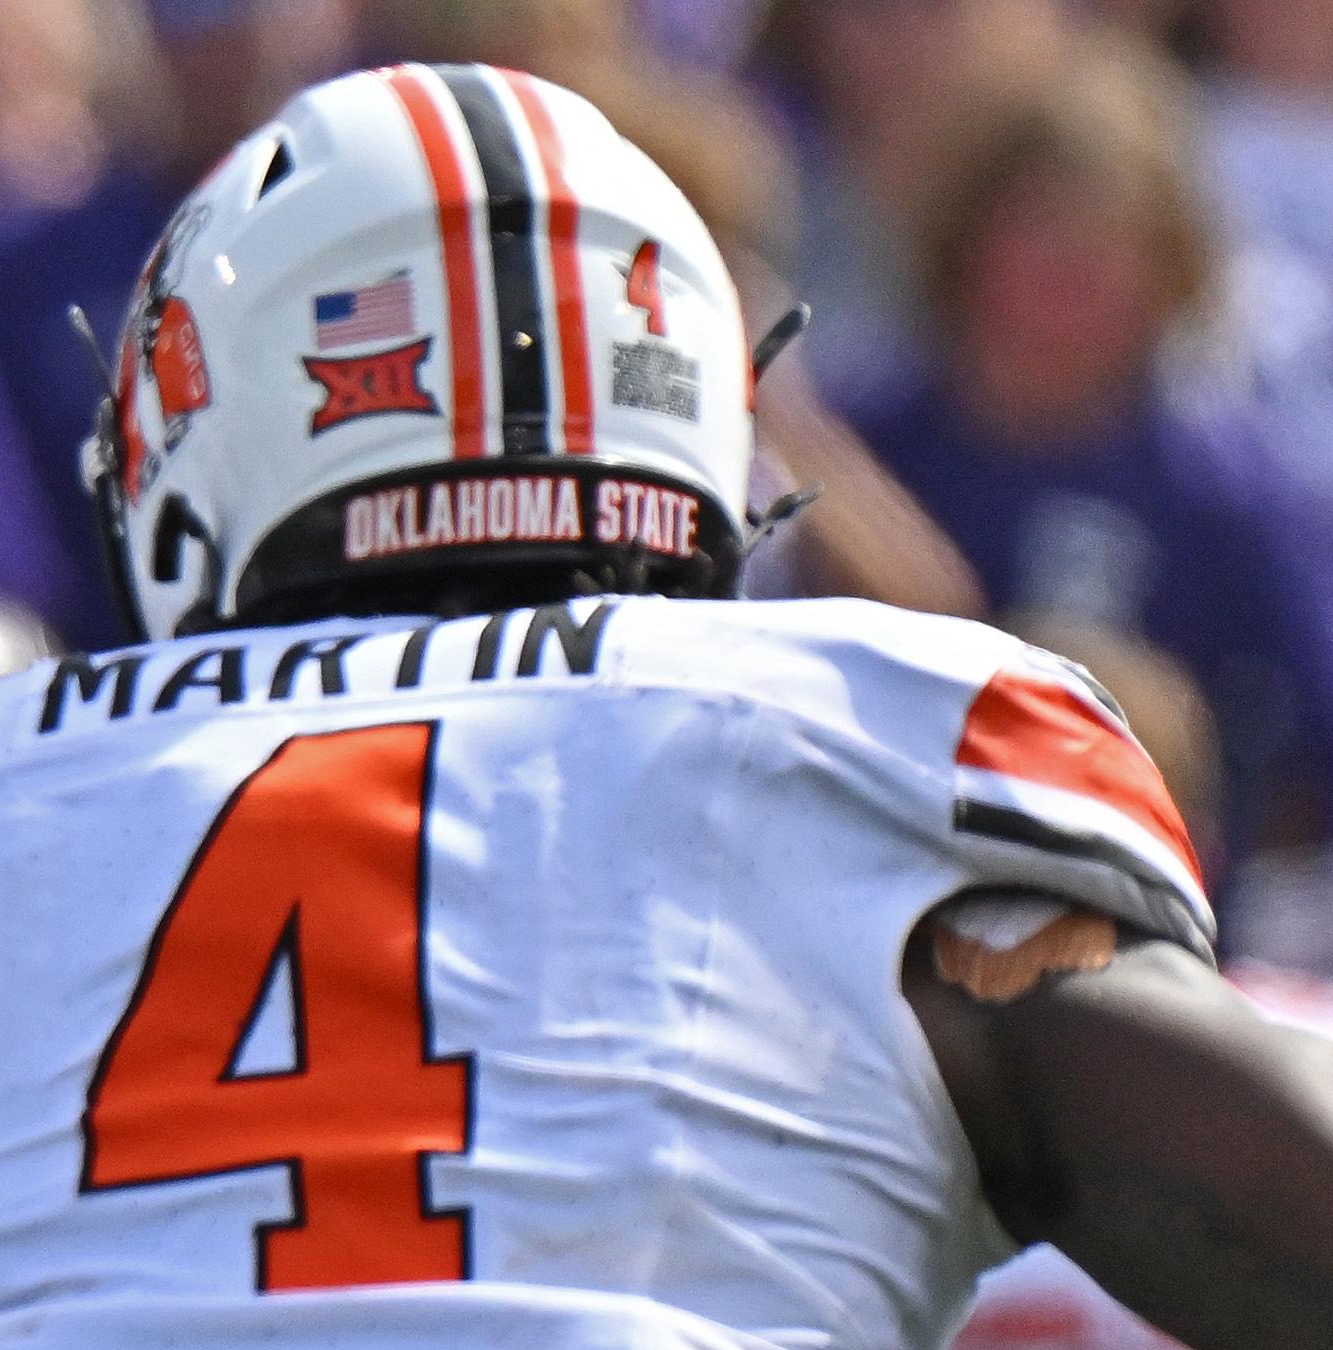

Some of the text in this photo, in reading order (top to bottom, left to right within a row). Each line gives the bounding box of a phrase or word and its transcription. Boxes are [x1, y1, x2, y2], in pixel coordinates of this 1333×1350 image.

[626, 240, 667, 337] 4
[344, 474, 700, 562] OKLAHOMA STATE
[78, 720, 475, 1296] 4
